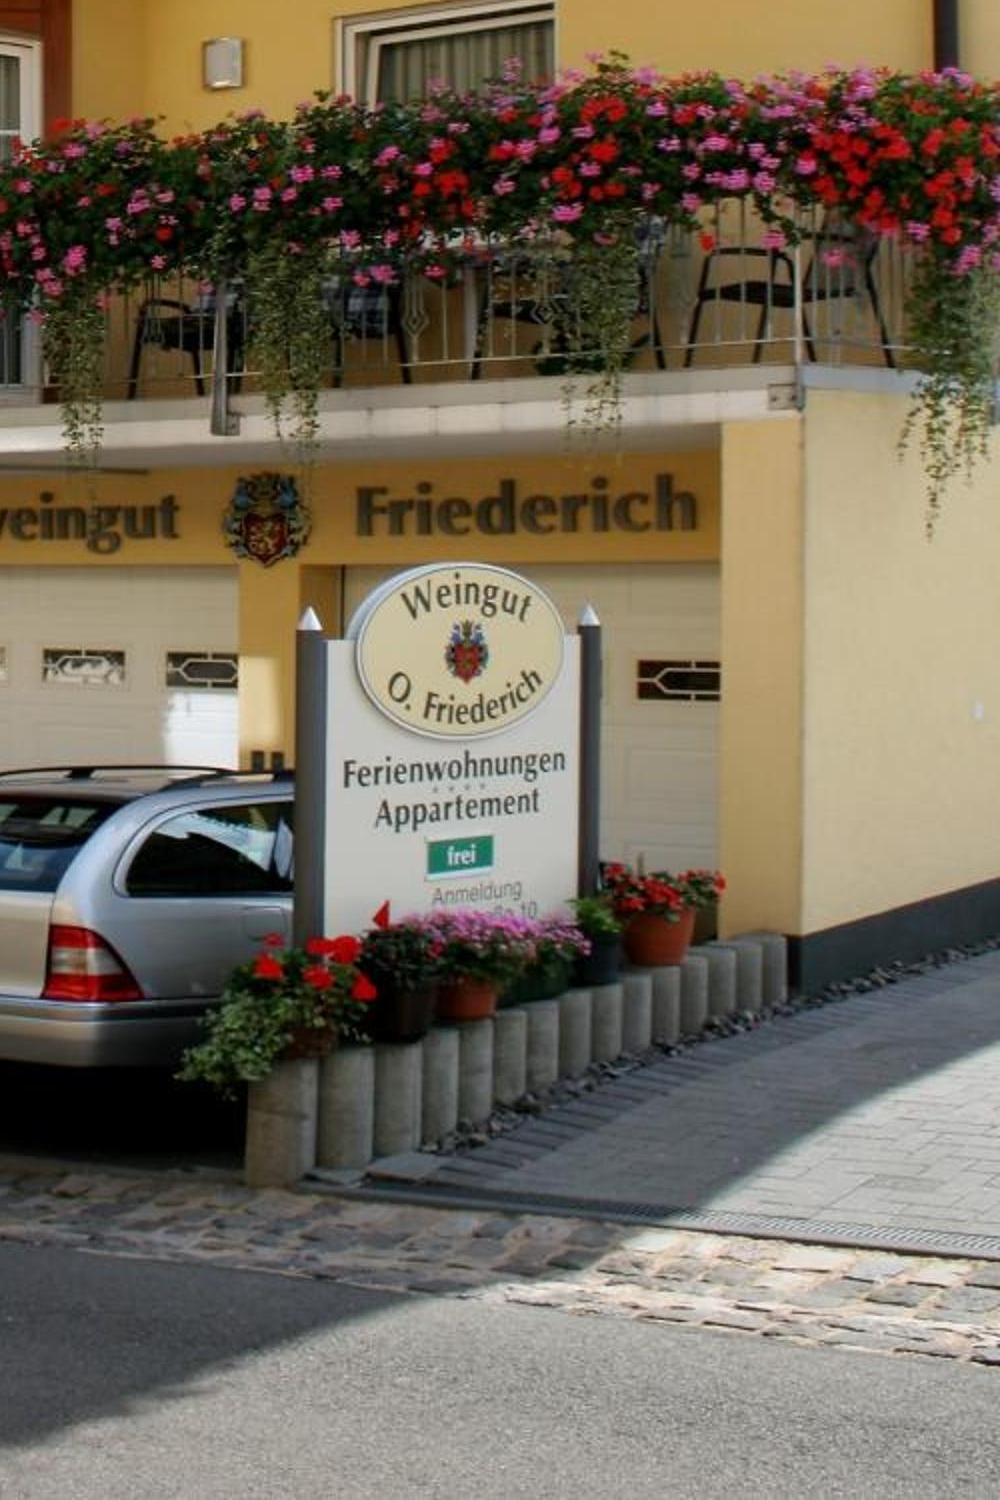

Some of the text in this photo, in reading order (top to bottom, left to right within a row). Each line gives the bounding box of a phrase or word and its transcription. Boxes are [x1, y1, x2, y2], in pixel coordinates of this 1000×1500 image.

[355, 473, 698, 537] Friederich
[401, 572, 532, 622] Weingut
[388, 668, 543, 725] O. Friederich
[342, 750, 567, 789] Ferienwohnungen
[374, 787, 541, 833] Appartement
[447, 843, 477, 866] frei
[432, 880, 523, 902] Anmeldung
